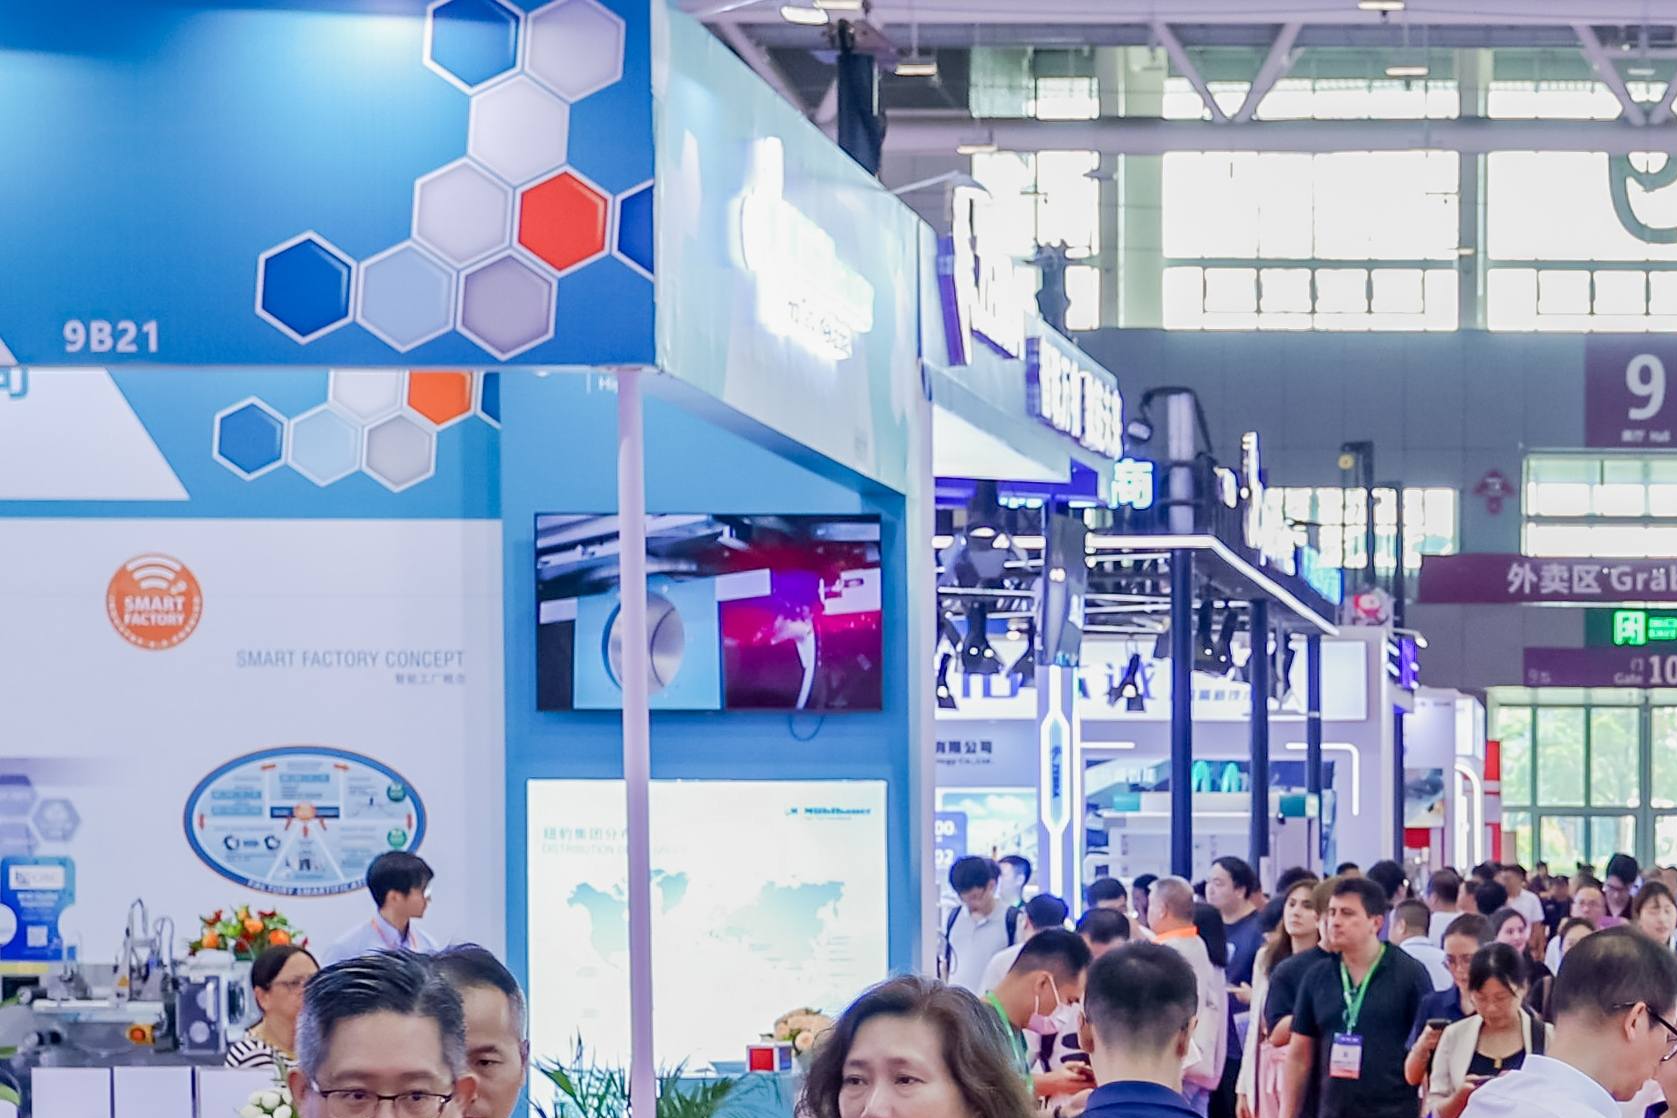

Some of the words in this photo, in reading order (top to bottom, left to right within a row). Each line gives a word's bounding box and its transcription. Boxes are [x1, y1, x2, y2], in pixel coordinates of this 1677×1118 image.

[63, 319, 157, 352] 9B21
[1626, 353, 1666, 420] 9
[1507, 563, 1601, 594] 外卖区
[124, 595, 185, 611] SMART
[123, 612, 185, 626] FACTORY
[236, 650, 295, 668] SMART
[302, 650, 378, 668] FACTORY
[385, 650, 463, 668] CONCEPT
